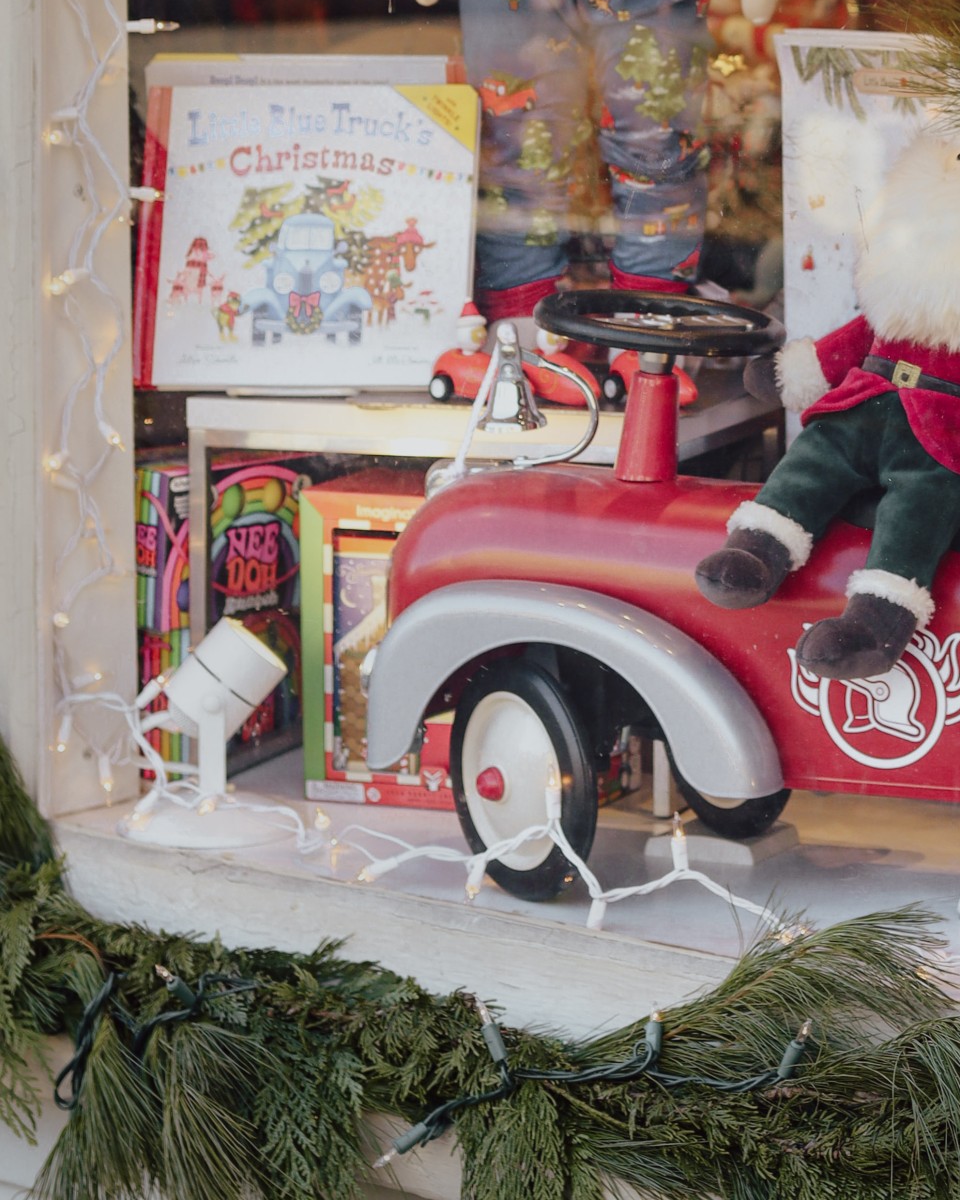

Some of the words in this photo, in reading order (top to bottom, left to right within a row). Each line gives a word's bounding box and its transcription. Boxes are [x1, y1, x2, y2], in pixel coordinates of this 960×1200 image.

[187, 110, 261, 146] Little
[267, 104, 326, 138] Blue
[331, 103, 435, 146] Truck's
[230, 143, 395, 177] Christmas
[137, 523, 158, 551] EE
[226, 521, 281, 565] NEE
[137, 543, 157, 568] OH
[227, 557, 278, 593] DOH
